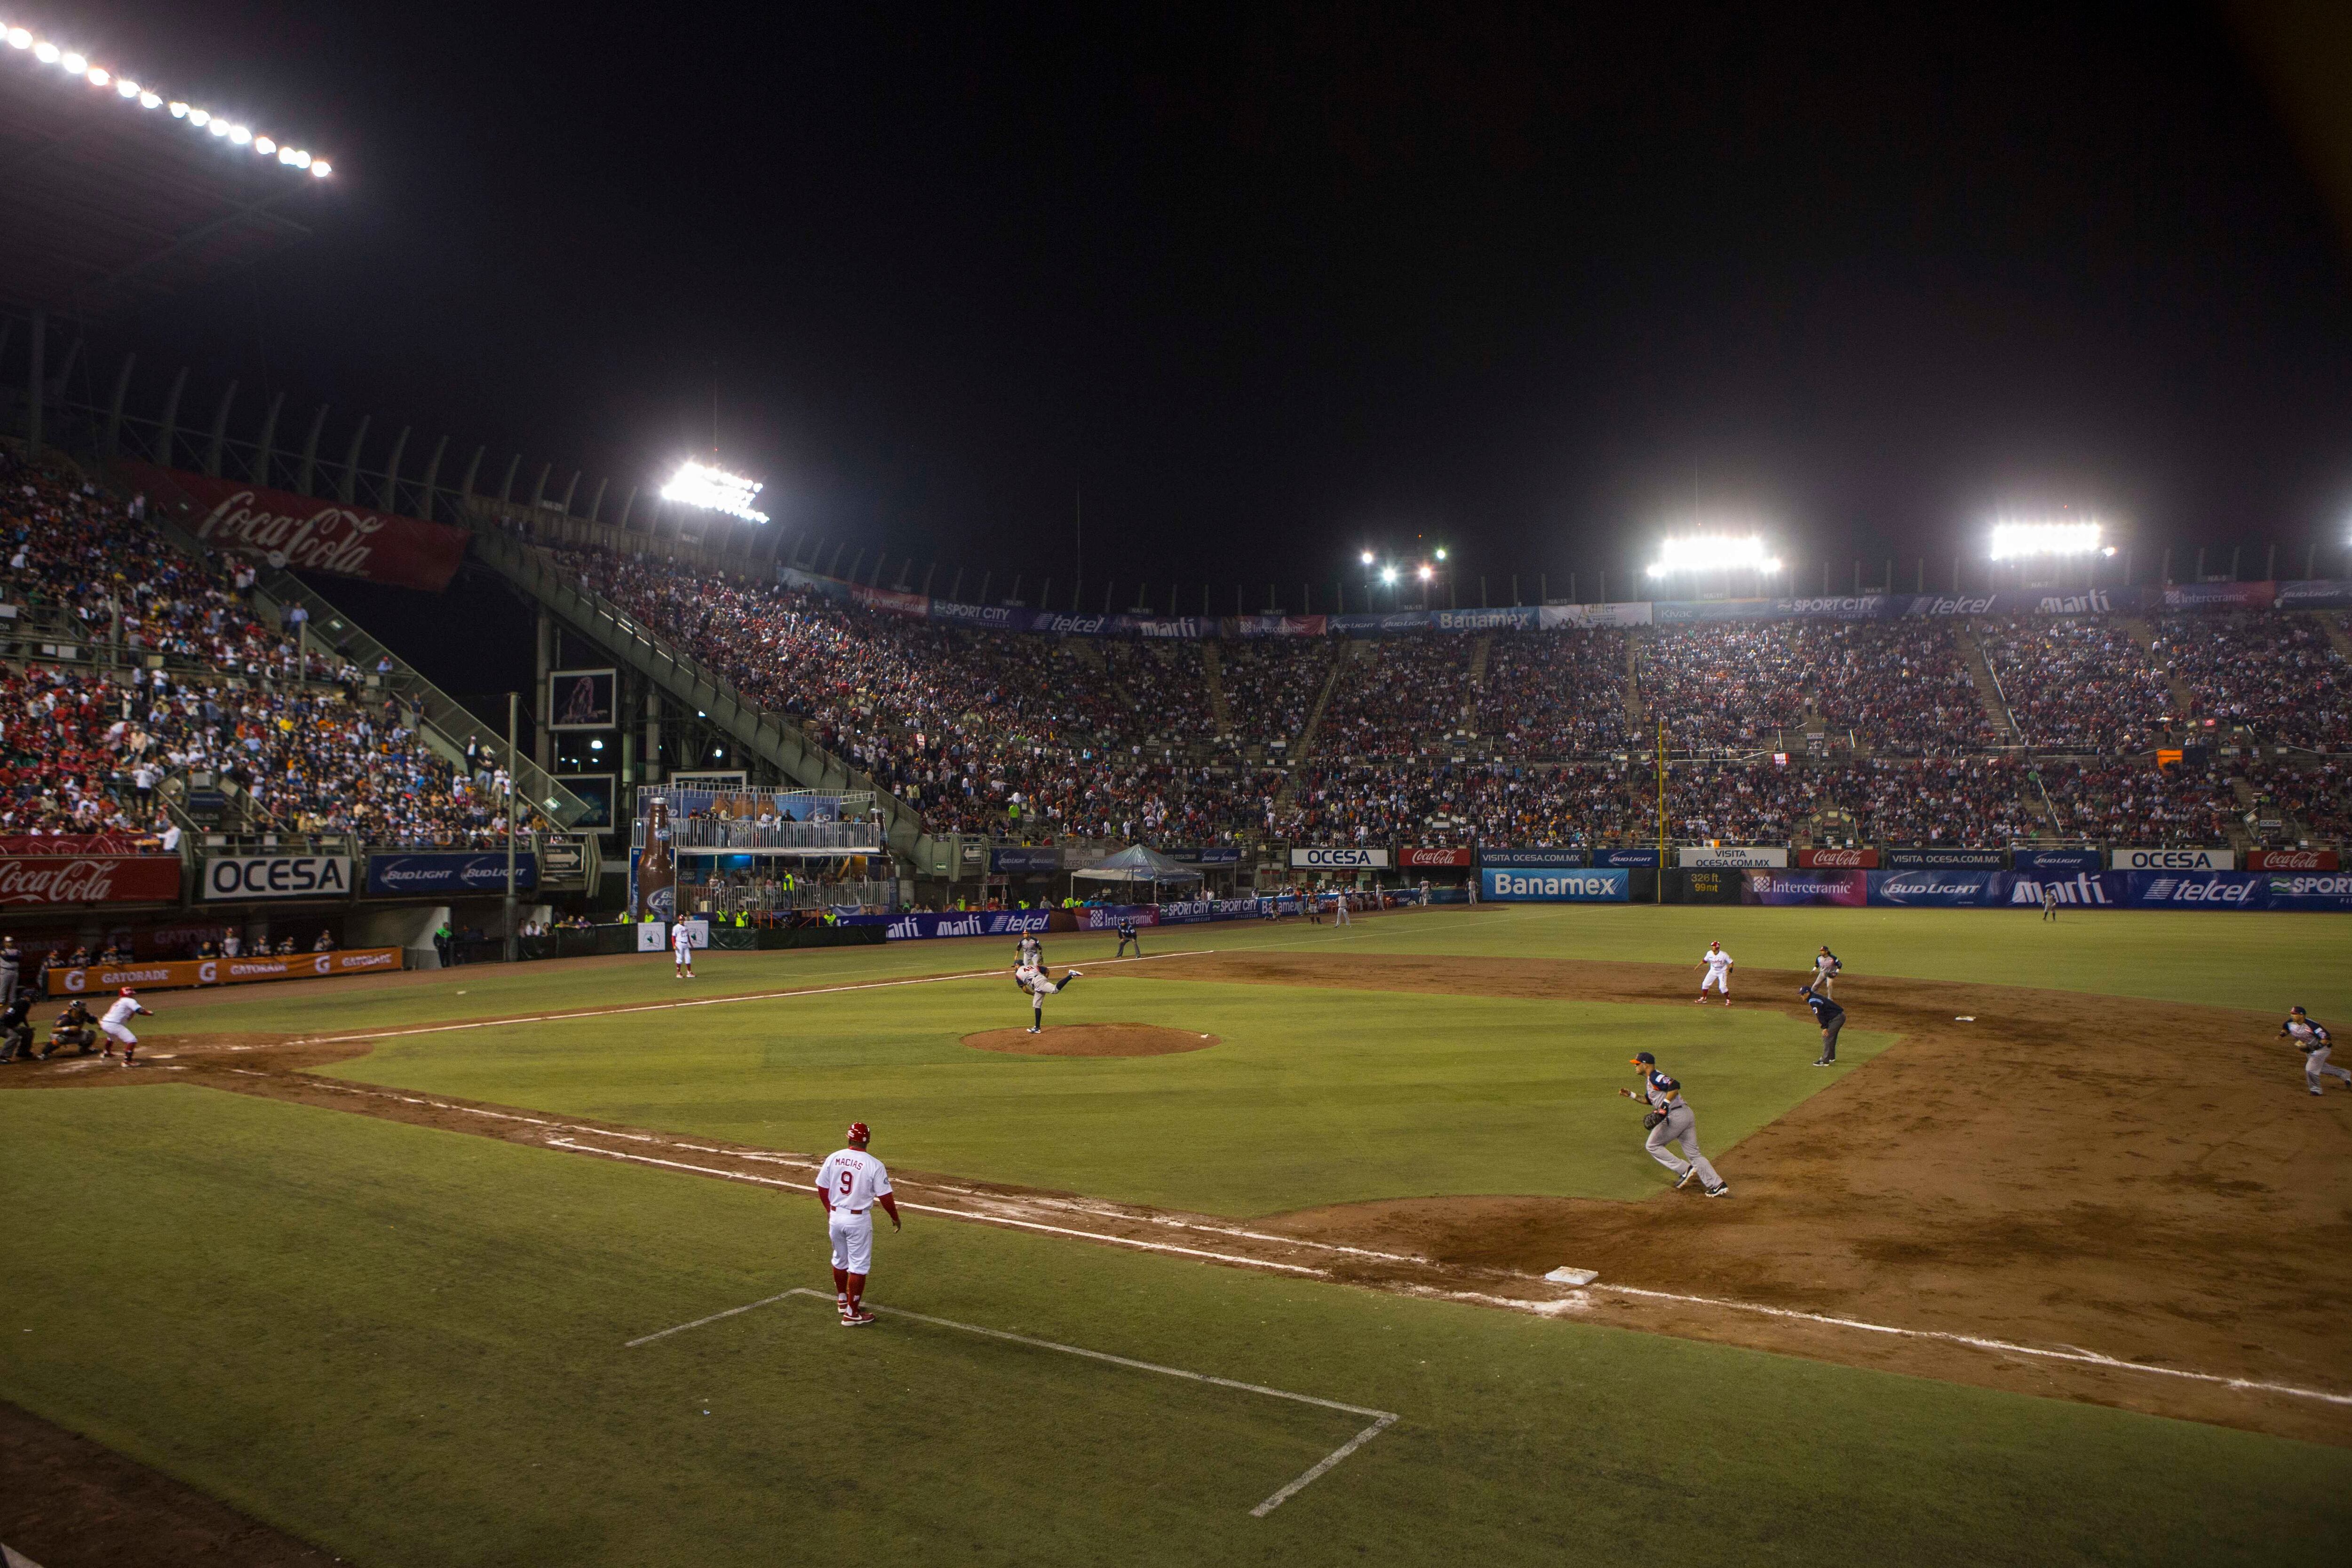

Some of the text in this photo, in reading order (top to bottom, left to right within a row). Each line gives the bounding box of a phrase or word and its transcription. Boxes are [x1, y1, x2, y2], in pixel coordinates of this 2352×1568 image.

[197, 491, 386, 574] Coca-Cola
[1793, 597, 1877, 612] SPORT CITY
[1930, 594, 1996, 614] telcel
[2182, 592, 2248, 604] Interceramic
[946, 602, 1010, 620] SPORT CITY
[1051, 614, 1105, 633] telcel
[1142, 617, 1196, 637] martí
[1440, 613, 1529, 629] Banamex
[1308, 850, 1371, 864] OCESA
[1412, 849, 1457, 864] Coca-Cola
[1813, 850, 1863, 865] Coca-Cola
[2132, 853, 2211, 868] OCESA
[2264, 851, 2321, 868] Coca-Cola
[213, 858, 344, 893] OCESA
[387, 871, 453, 879] BUD LIGHT
[467, 869, 491, 877] BUD
[1691, 873, 1721, 882] 326 ft.
[1495, 874, 1615, 895] Banamex
[1773, 880, 1851, 894] Interceramic
[1888, 884, 1981, 894] BUD LIGHT
[2012, 872, 2106, 903] martí
[2173, 879, 2256, 901] telcel
[1169, 902, 1210, 916] SPORT CITY
[1221, 899, 1258, 912] SPORT CITY
[1262, 901, 1298, 914] Baamex
[937, 915, 982, 935] martí
[1006, 914, 1049, 932] telcel
[1105, 911, 1153, 926] Inteeramic
[886, 917, 922, 939] artí
[314, 955, 330, 974] G
[342, 953, 392, 966] GATORADE
[101, 970, 169, 984] GATORADE
[199, 962, 217, 982] G
[64, 970, 85, 991] G
[835, 1158, 863, 1170] MACIAS
[840, 1171, 854, 1196] 9
